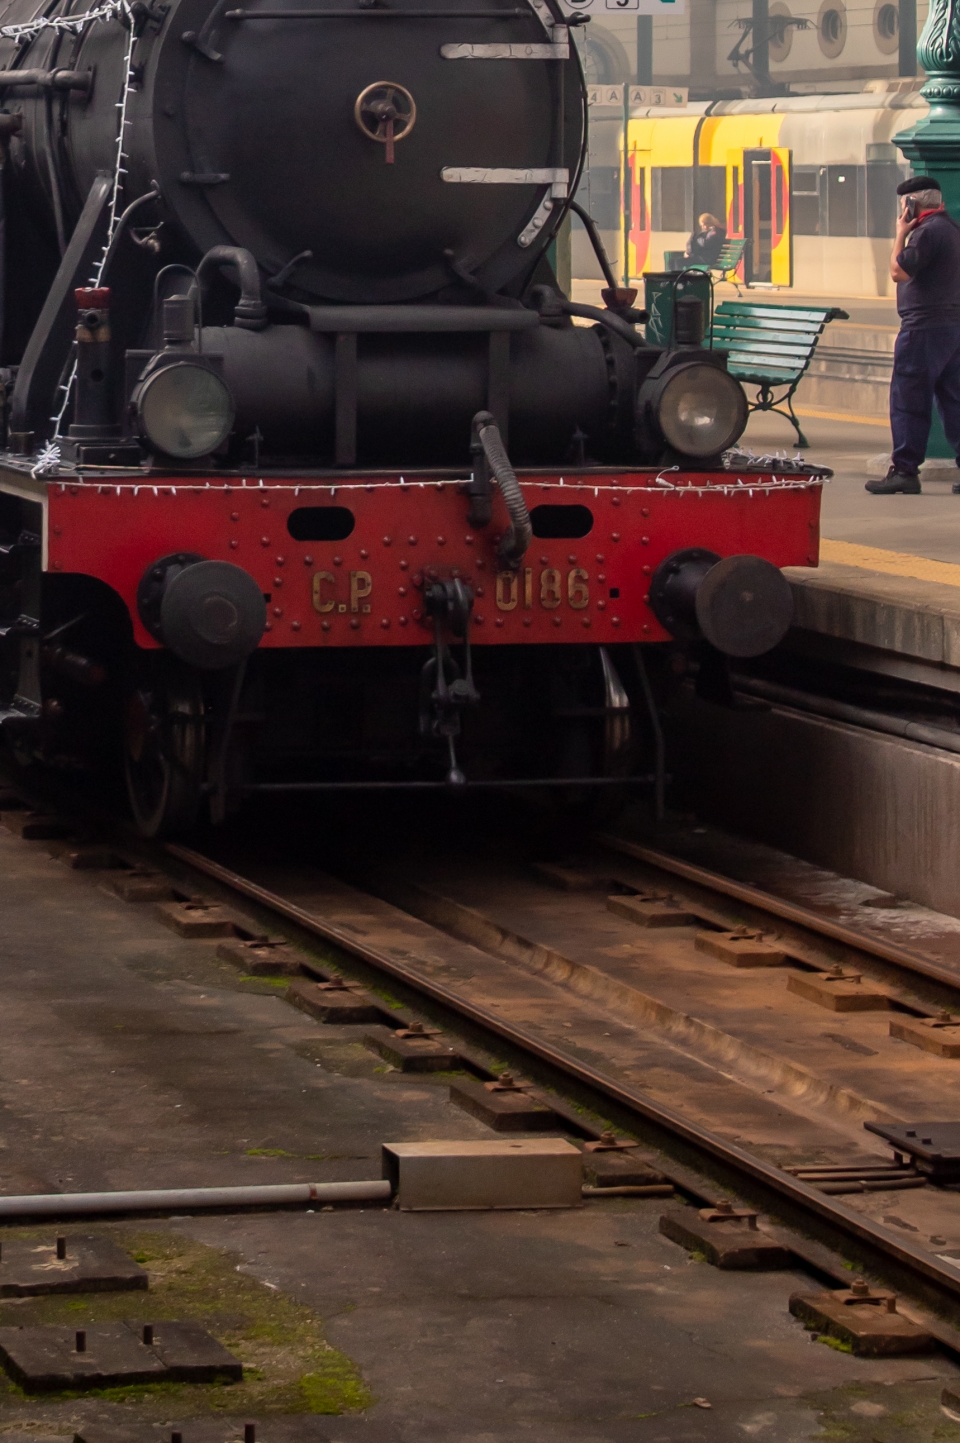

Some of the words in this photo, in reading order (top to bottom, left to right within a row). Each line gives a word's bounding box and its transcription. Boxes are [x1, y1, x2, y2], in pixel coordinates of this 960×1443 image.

[590, 91, 598, 102] 4
[609, 90, 619, 101] A
[633, 91, 643, 102] A
[311, 569, 373, 614] C.P.
[495, 567, 590, 611] 0186
